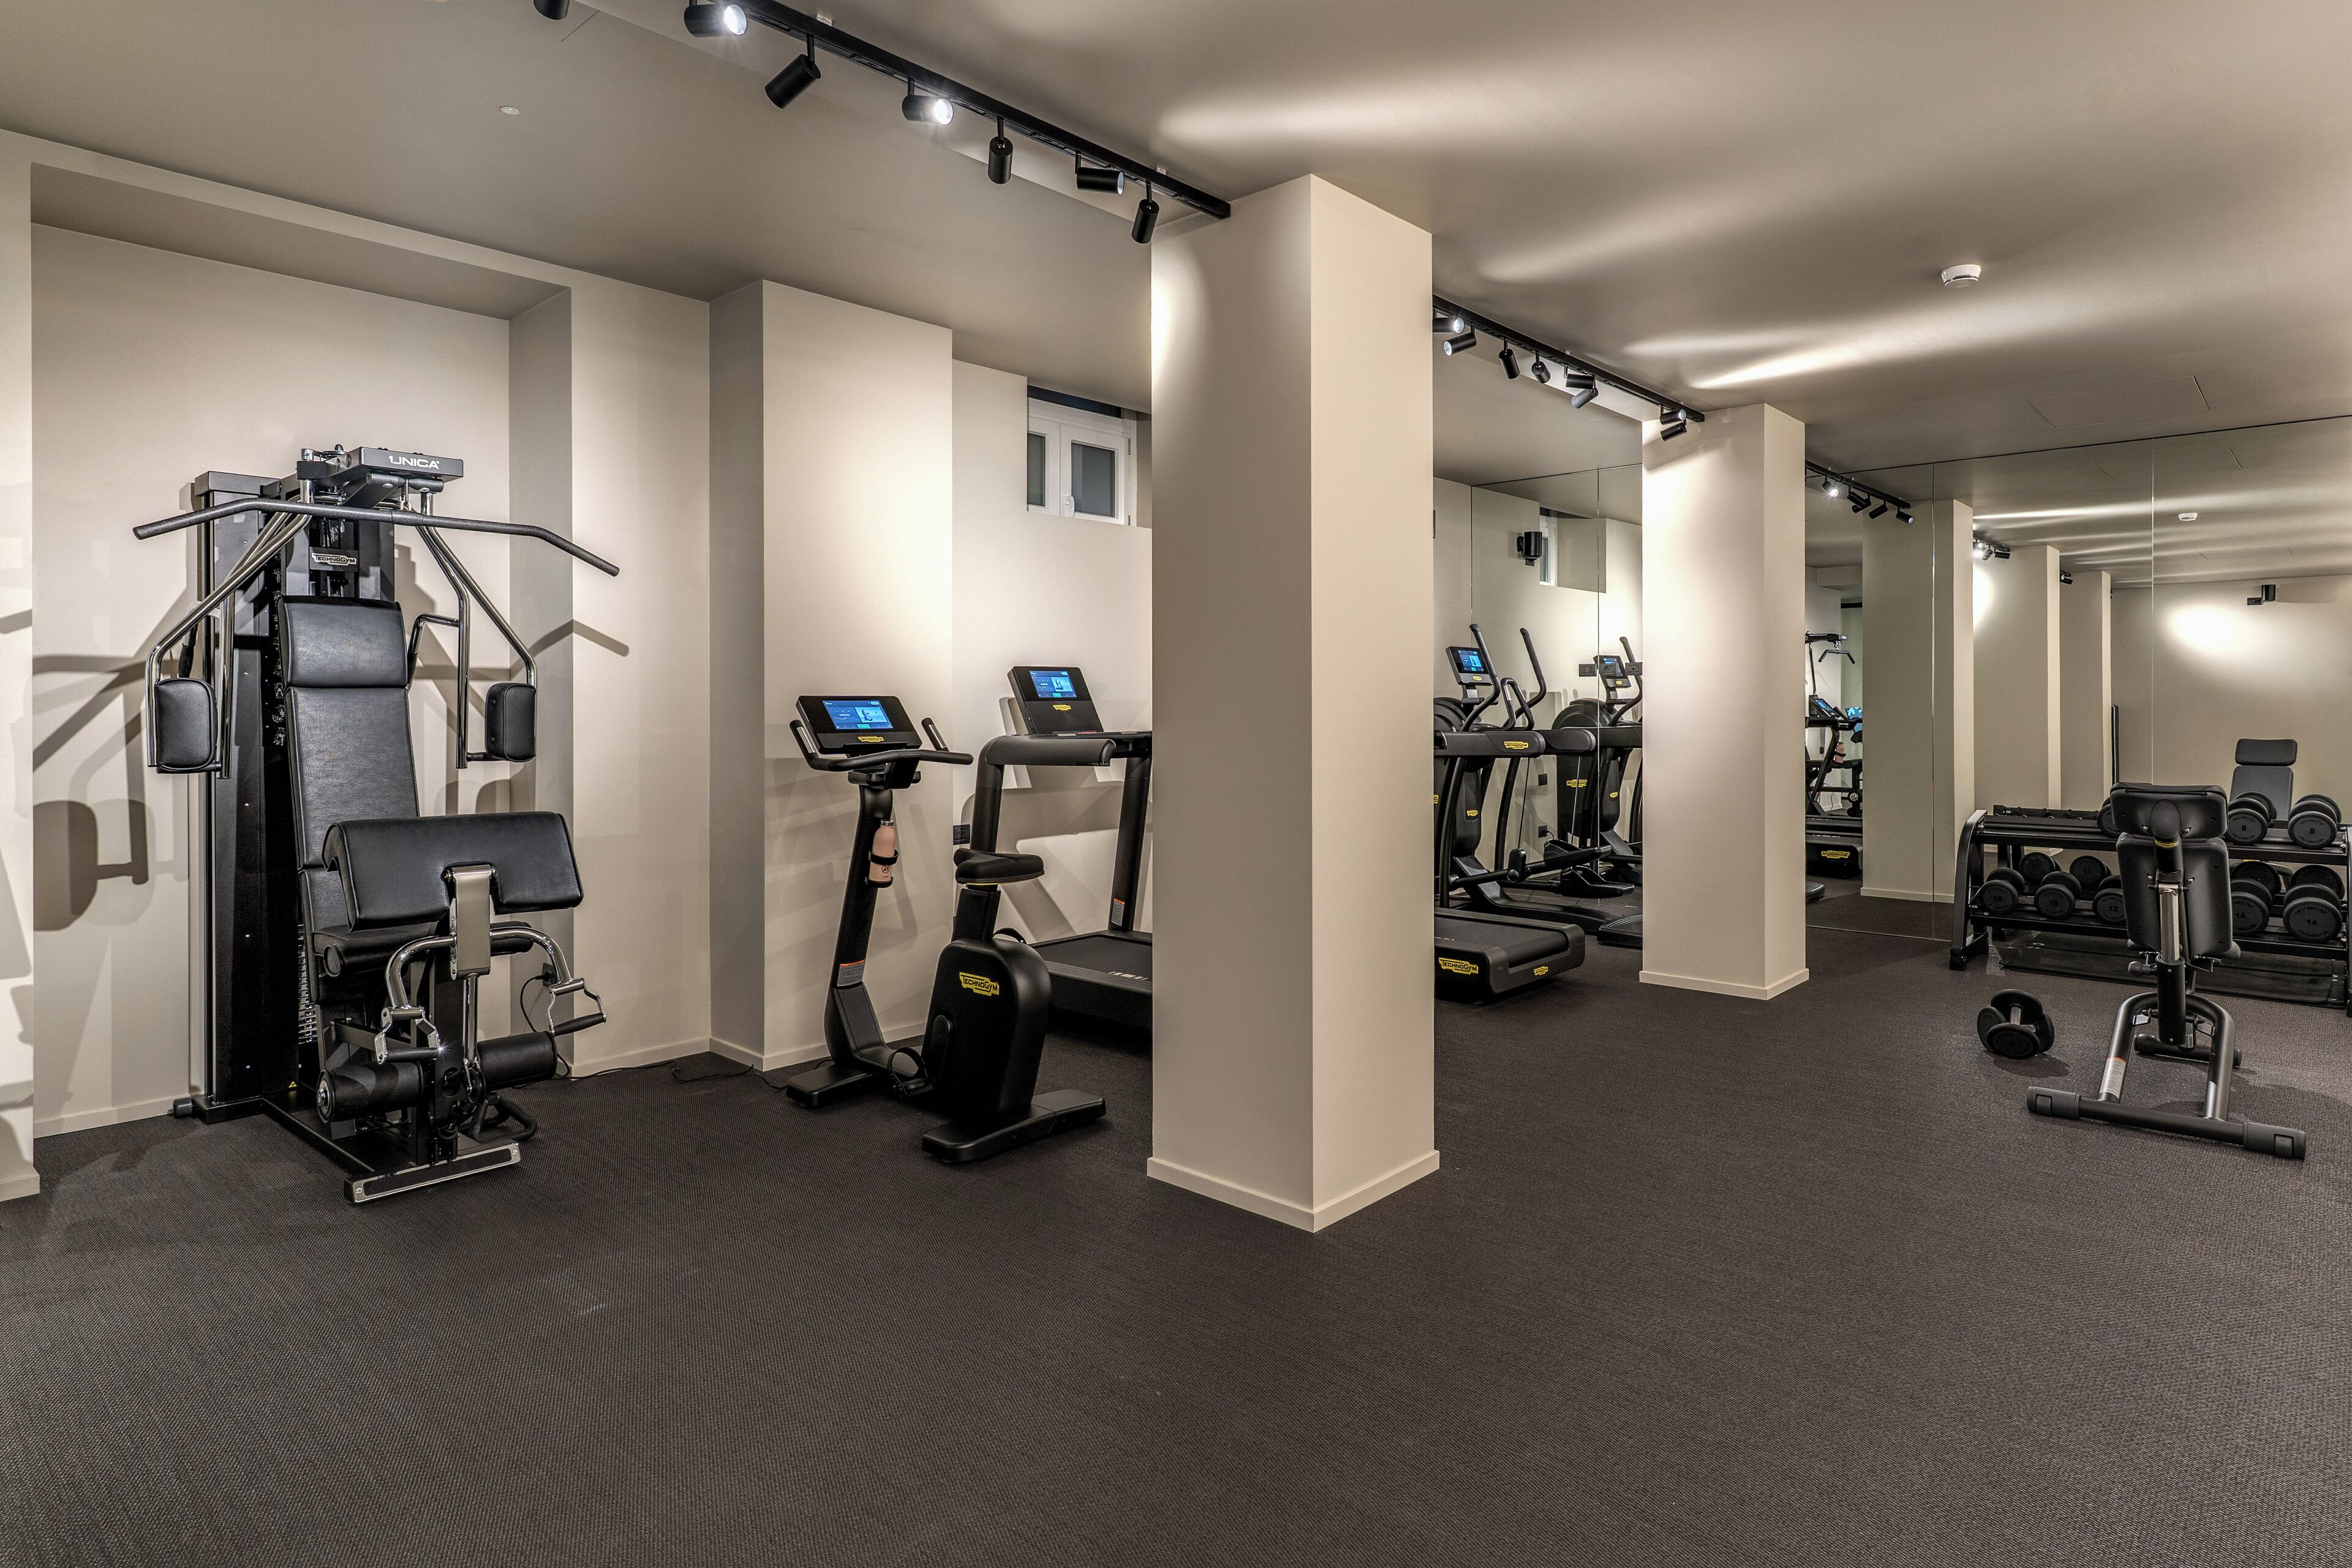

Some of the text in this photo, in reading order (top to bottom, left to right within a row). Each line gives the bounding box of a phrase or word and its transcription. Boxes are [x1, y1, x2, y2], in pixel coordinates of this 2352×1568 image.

[388, 455, 439, 470] UNICA
[312, 554, 356, 564] TECHNOGYM
[1440, 959, 1478, 972] TECHNOGYM
[960, 974, 998, 992] TECHNOGYM
